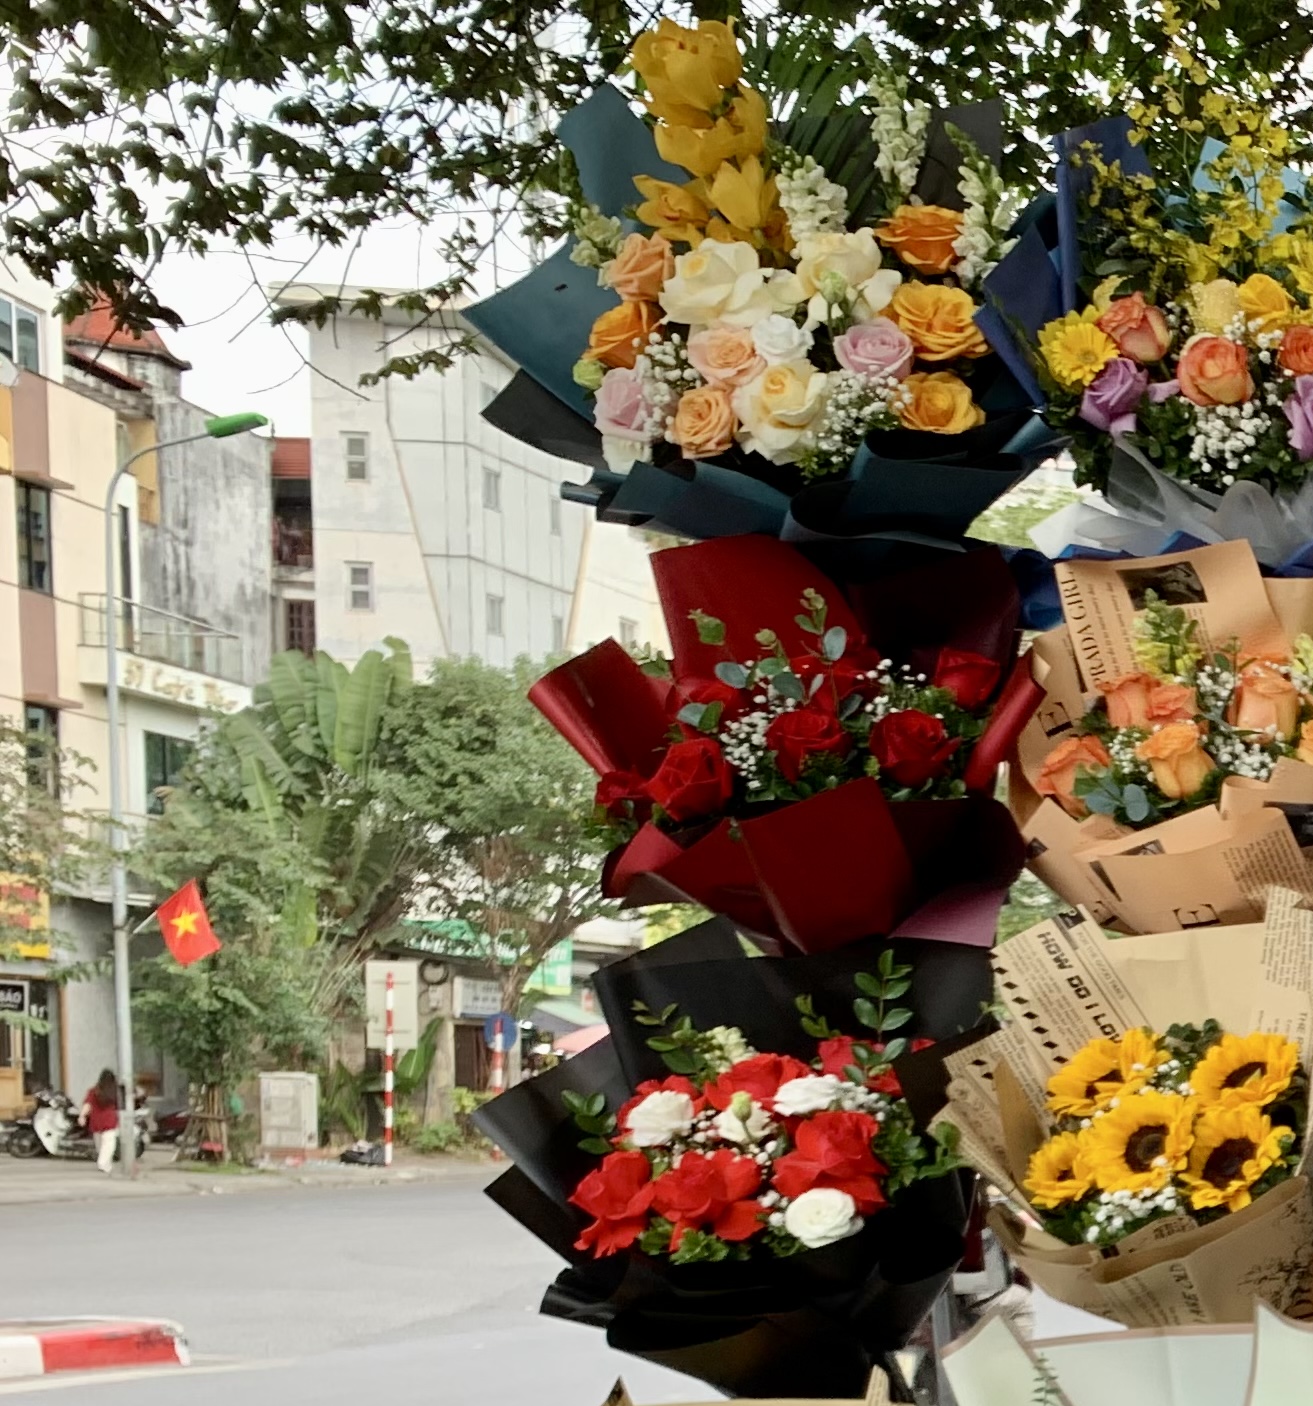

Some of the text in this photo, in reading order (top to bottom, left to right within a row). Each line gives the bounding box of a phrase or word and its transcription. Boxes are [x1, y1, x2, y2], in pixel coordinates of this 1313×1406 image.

[1037, 931, 1073, 970] HOW
[1066, 975, 1091, 999] DO
[1085, 1002, 1099, 1010] I
[1093, 1012, 1122, 1044] LOV
